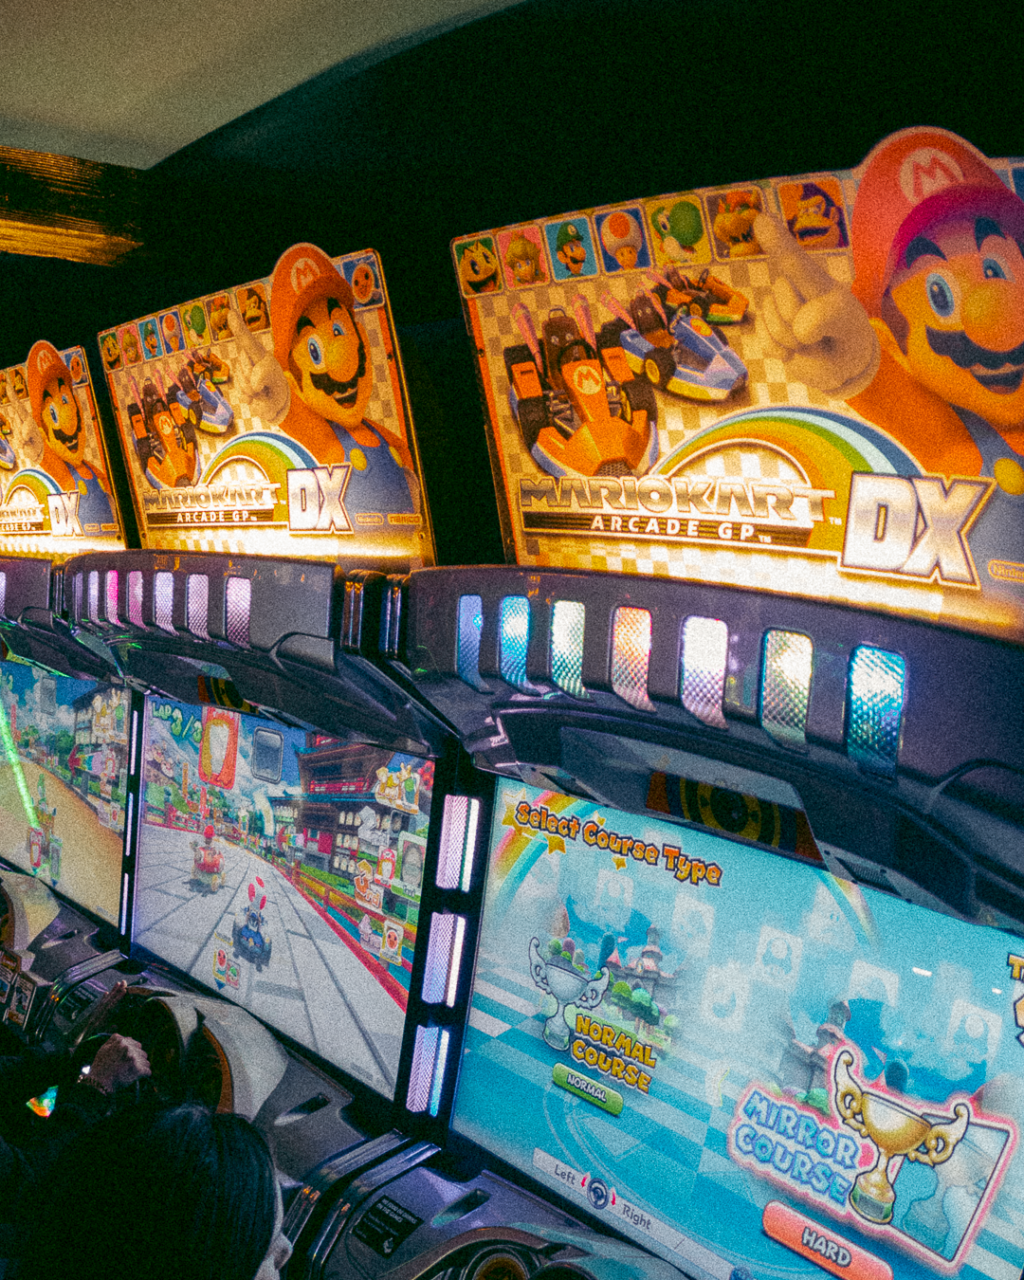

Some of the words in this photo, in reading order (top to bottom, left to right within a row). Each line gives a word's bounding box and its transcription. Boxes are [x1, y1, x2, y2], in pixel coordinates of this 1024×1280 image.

[47, 492, 85, 537] DX
[177, 512, 225, 523] ARCADE
[233, 511, 249, 521] GP
[287, 465, 354, 534] DX
[590, 515, 700, 537] ARCADE
[718, 523, 756, 541] GP
[840, 472, 997, 591] DX
[515, 800, 580, 841] Select
[581, 819, 660, 866] Course
[662, 842, 723, 887] Type
[576, 1014, 657, 1069] NORMAL
[566, 1073, 608, 1103] NORMAL
[571, 1040, 652, 1095] COURSE
[742, 1090, 860, 1170] MIRROR
[554, 1163, 576, 1186] Left
[735, 1123, 853, 1208] COURSE
[622, 1204, 652, 1231] Right
[802, 1226, 852, 1268] HARD
